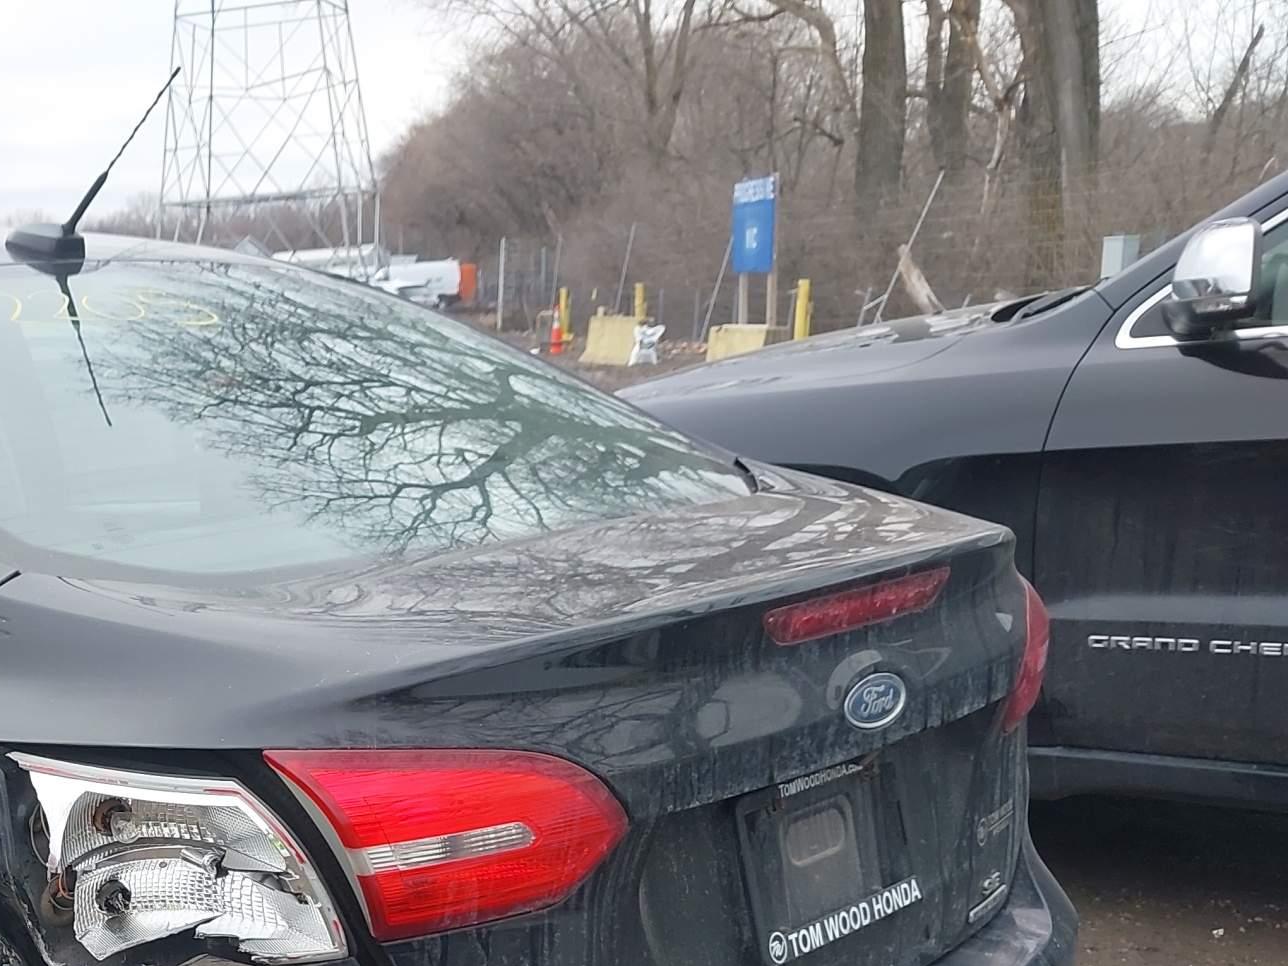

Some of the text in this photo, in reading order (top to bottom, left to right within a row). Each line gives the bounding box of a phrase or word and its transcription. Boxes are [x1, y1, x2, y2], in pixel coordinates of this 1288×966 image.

[1087, 634, 1288, 656] GRAND CHE
[788, 922, 824, 958] TOM
[823, 901, 871, 942] WOOD
[871, 878, 922, 920] HONDA
